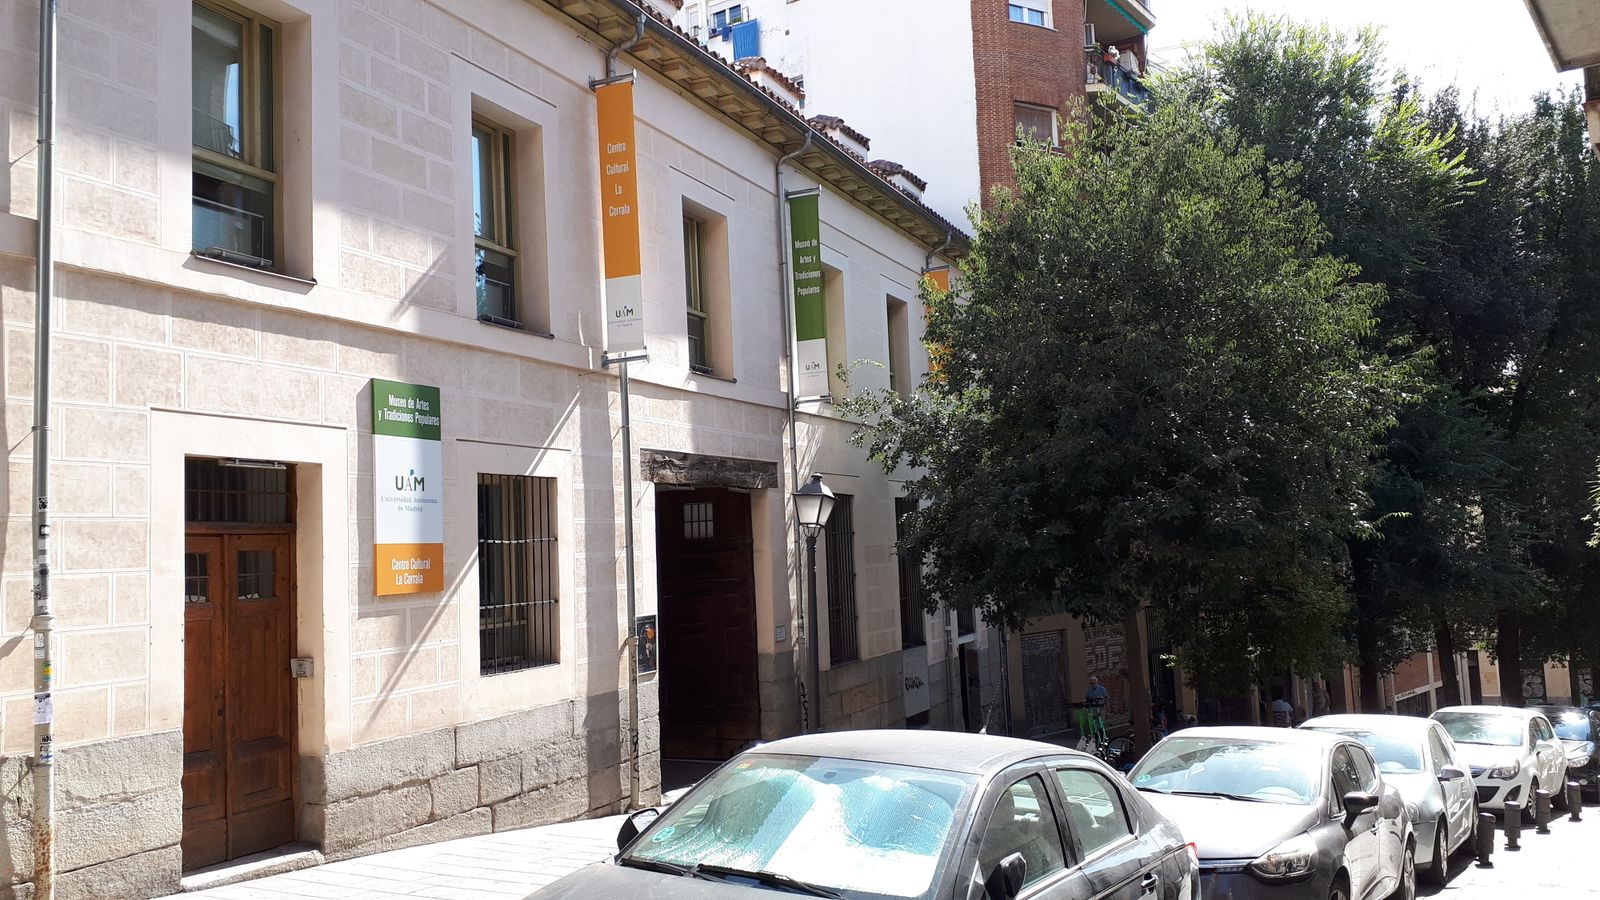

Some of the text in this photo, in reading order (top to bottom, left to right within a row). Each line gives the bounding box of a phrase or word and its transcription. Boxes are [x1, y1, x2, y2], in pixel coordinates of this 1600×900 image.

[607, 142, 627, 154] Centro
[606, 161, 629, 176] Cultural
[614, 183, 623, 195] La
[608, 203, 631, 217] Corrala
[794, 238, 818, 249] Museo de
[799, 255, 812, 264] Artes
[794, 270, 821, 281] Tradiciones
[797, 286, 820, 297] Populares
[388, 394, 430, 411] Museo de Artes
[377, 407, 440, 426] y Tradiciones Populares
[395, 475, 425, 492] UAM
[391, 557, 431, 570] Centro Cultural
[395, 572, 424, 585] La Corrala
